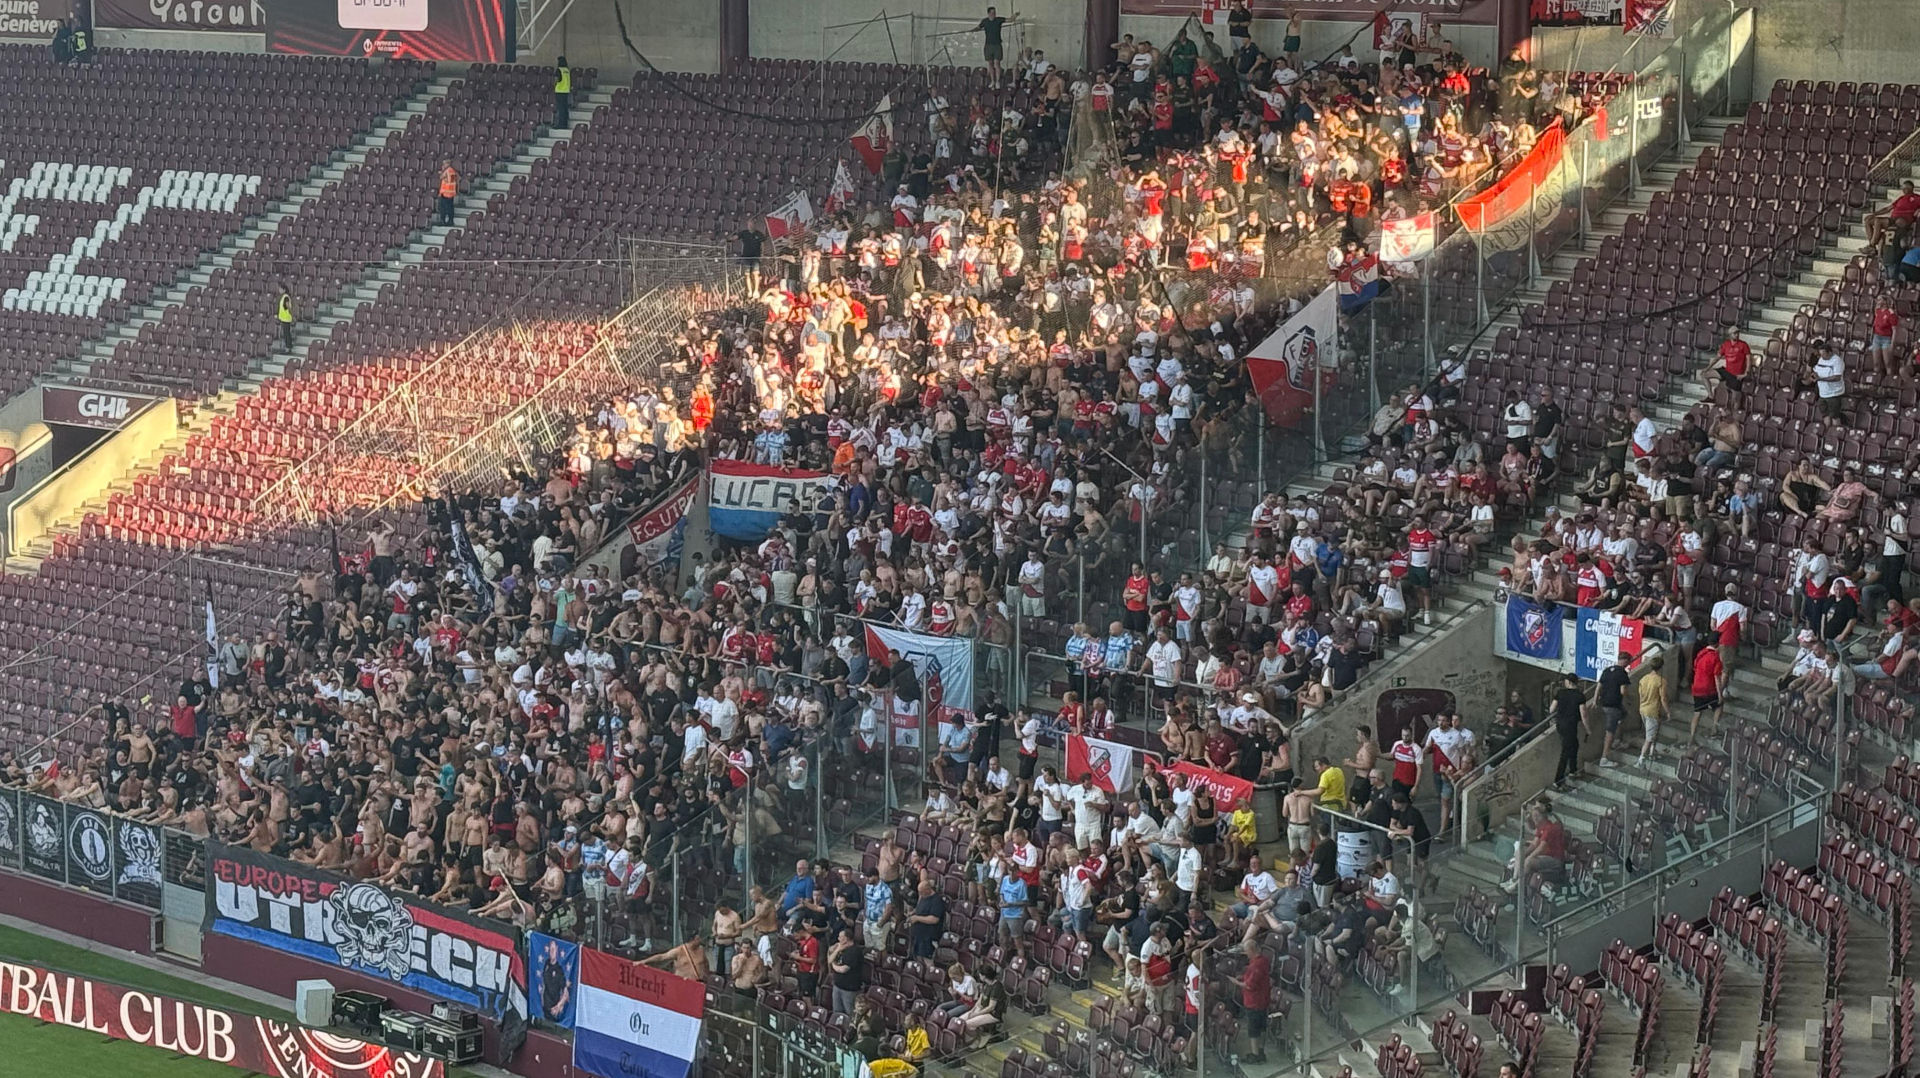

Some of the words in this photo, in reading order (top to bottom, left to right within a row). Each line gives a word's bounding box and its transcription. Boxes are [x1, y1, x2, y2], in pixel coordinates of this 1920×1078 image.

[1546, 0, 1560, 14] FC
[0, 14, 59, 33] Genève
[711, 477, 817, 511] LUCAS
[1602, 640, 1615, 656] LA
[217, 860, 318, 902] EUROPE
[618, 963, 666, 1000] Utrecht
[120, 991, 236, 1063] CLUB
[630, 1011, 650, 1036] On
